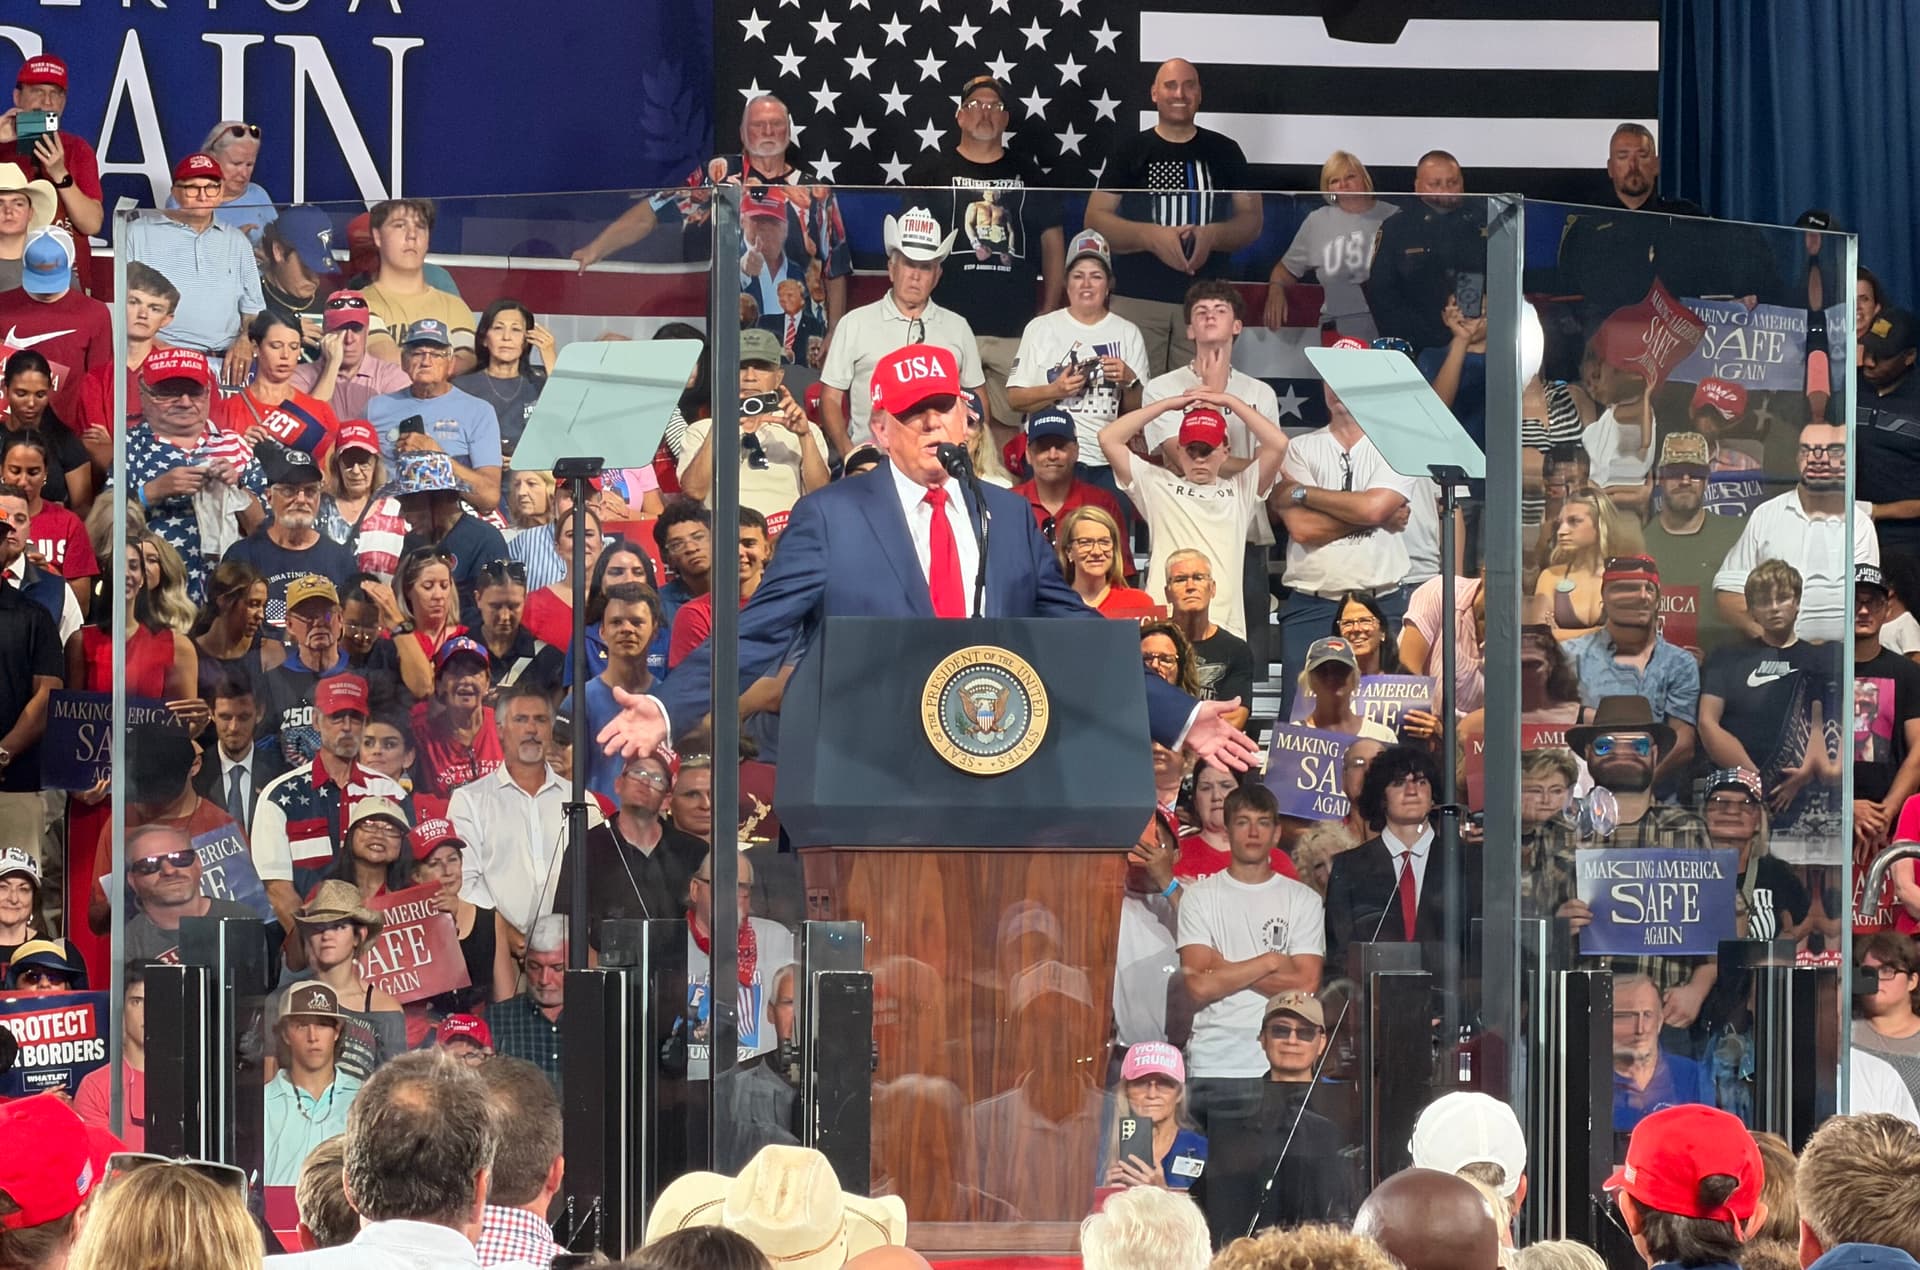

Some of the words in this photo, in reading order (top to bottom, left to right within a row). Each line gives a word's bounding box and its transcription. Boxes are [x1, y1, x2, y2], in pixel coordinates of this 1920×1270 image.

[904, 219, 935, 234] TRUMP
[1751, 310, 1806, 336] AMERICA
[1702, 326, 1786, 364] SAFE
[894, 356, 947, 383] USA
[983, 651, 997, 663] OF
[998, 656, 1015, 670] THE
[925, 650, 981, 707] PRESIDENT
[1016, 664, 1044, 718] UNITED
[1364, 683, 1429, 699] AMERICA
[926, 711, 941, 730] THE
[75, 723, 113, 763] SA
[935, 732, 948, 744] OF
[998, 728, 1040, 768] STATES
[1277, 731, 1340, 759] MAKING
[942, 744, 975, 768] SEAL
[1297, 756, 1346, 798] SA
[415, 820, 449, 837] TRUMP
[196, 835, 243, 867] ERICA
[1584, 861, 1654, 881] MAKING
[1655, 862, 1725, 881] AMERICA
[383, 897, 439, 929] MERIC
[1610, 882, 1701, 925] SAFE
[1644, 926, 1684, 946] AGAIN
[24, 1037, 106, 1068] BORDERS
[27, 1071, 69, 1084] WHATLEY
